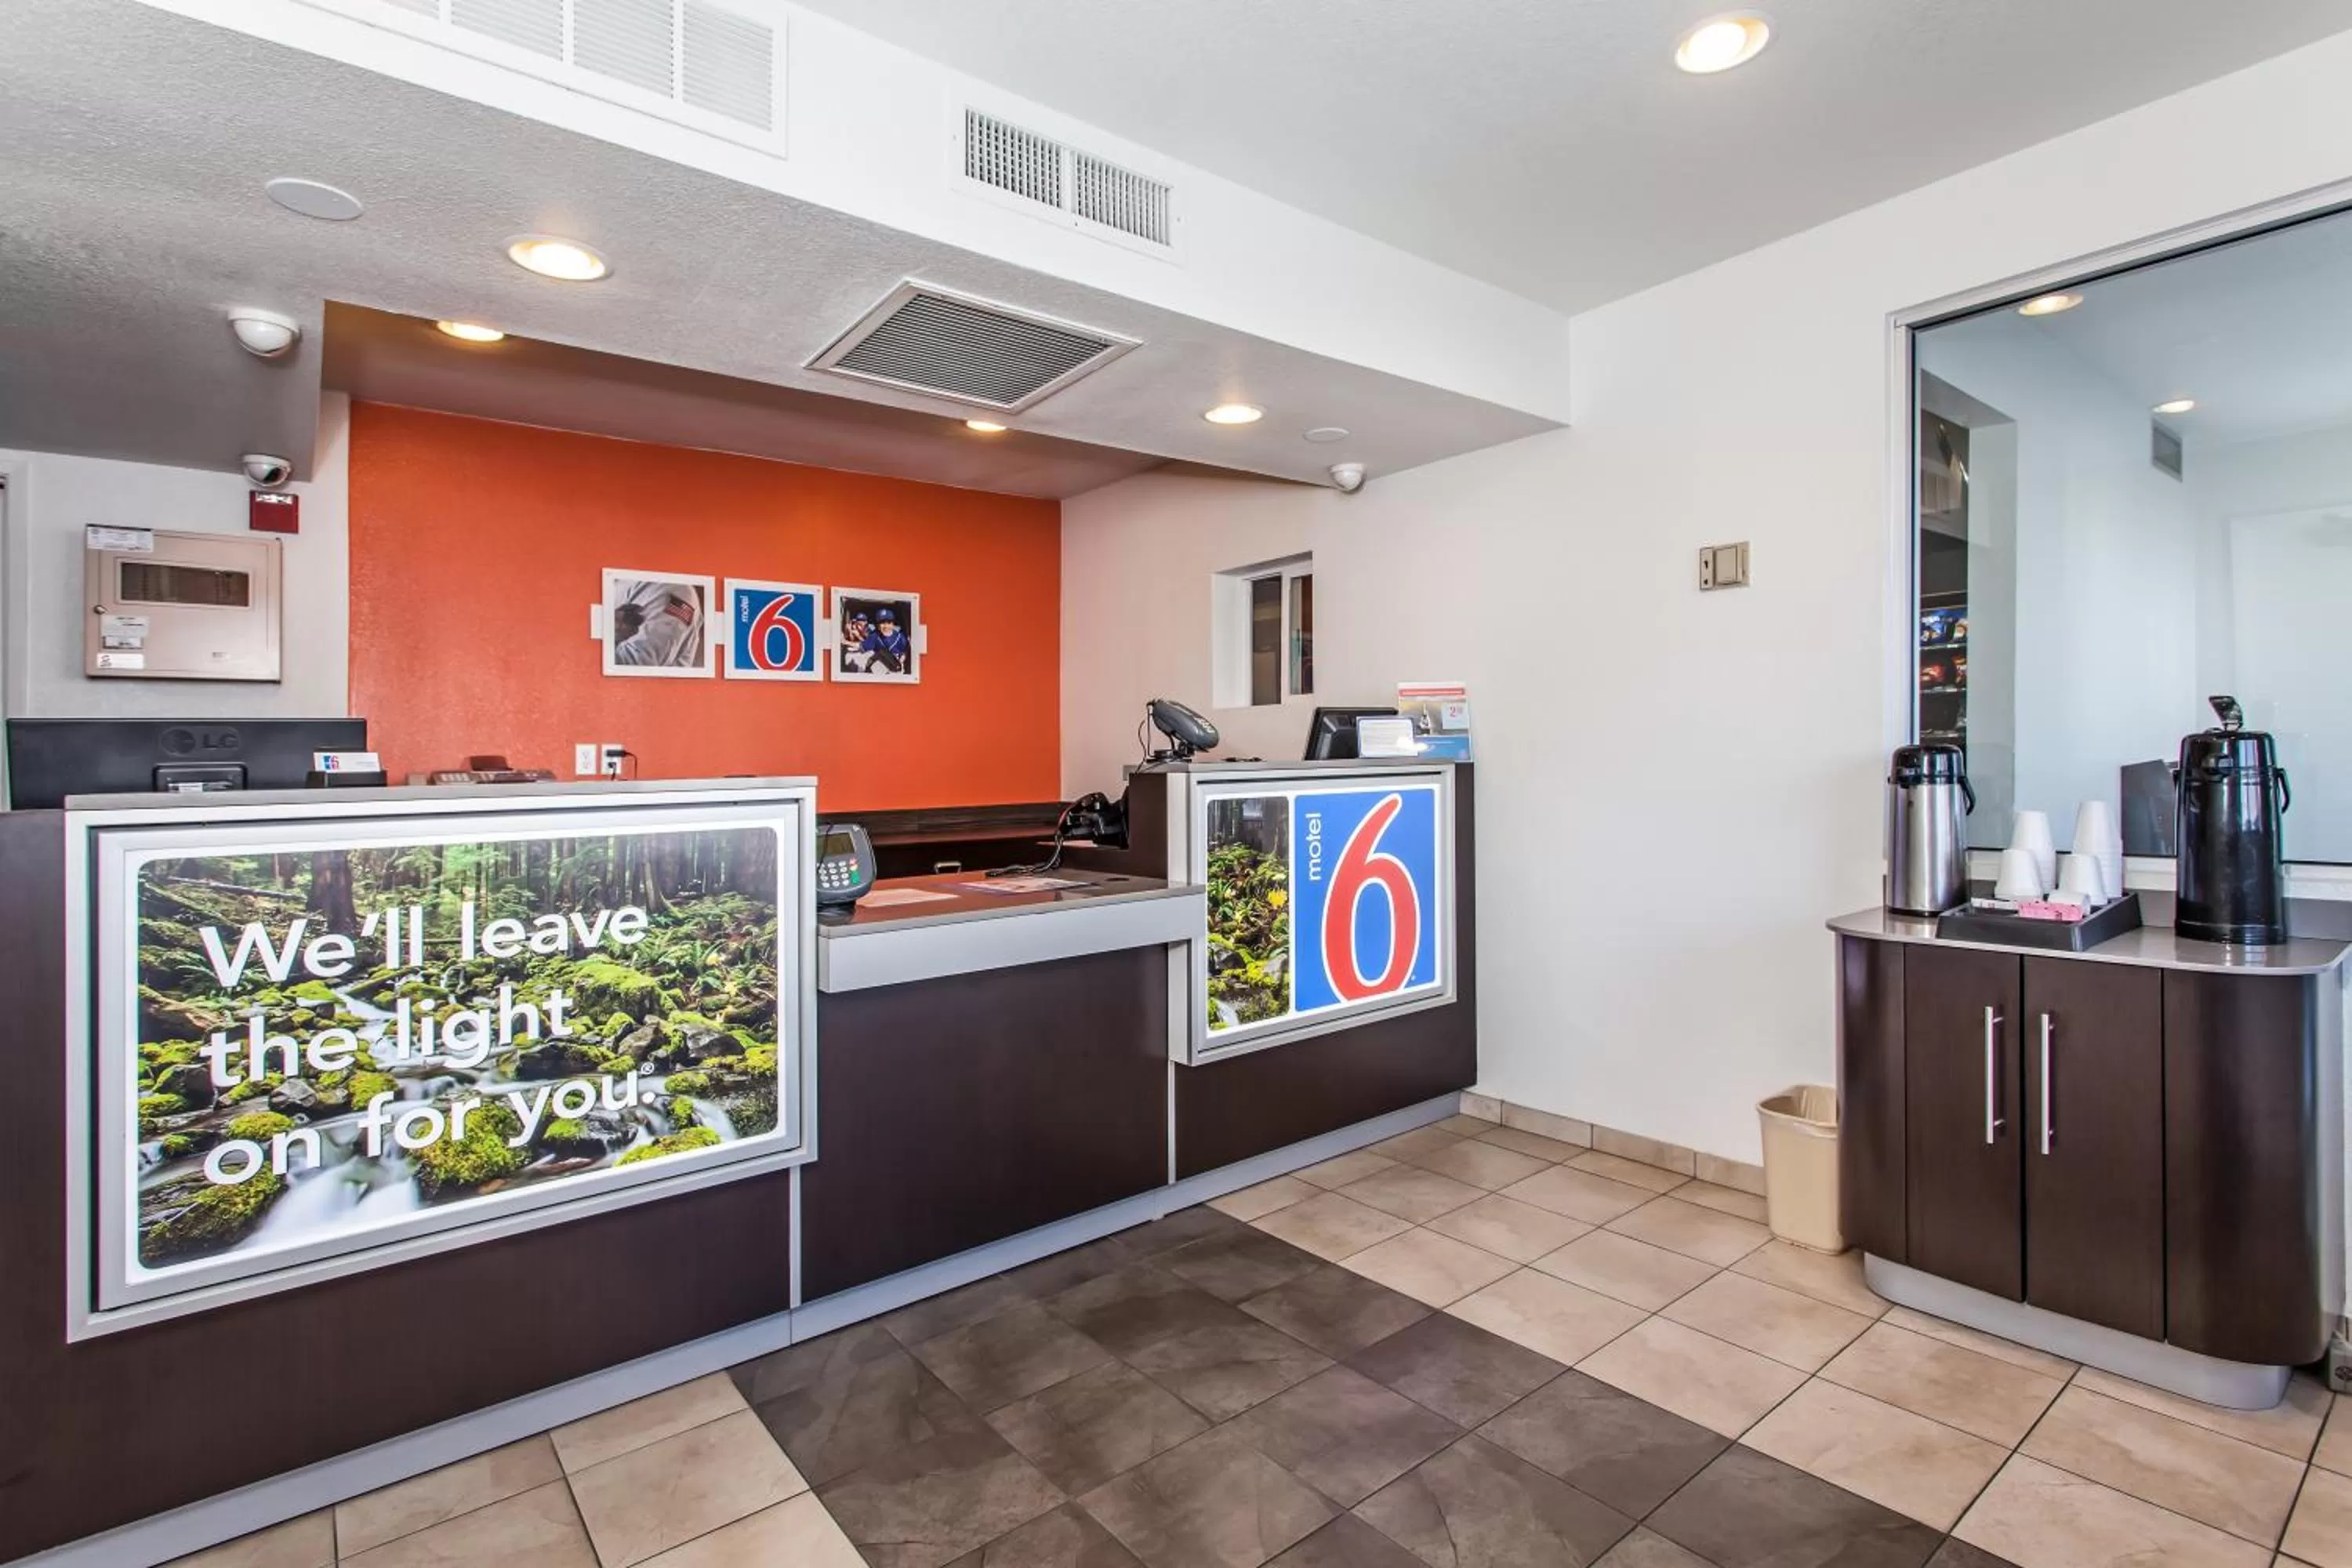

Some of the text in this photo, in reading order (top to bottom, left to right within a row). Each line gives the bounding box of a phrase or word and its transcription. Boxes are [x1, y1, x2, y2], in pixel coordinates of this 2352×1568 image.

[739, 594, 804, 672] motel 6
[201, 733, 238, 749] LG
[1305, 793, 1421, 1004] motel 6
[199, 901, 648, 987] We'll leave
[200, 985, 573, 1088] the light
[204, 1127, 321, 1185] on
[358, 1091, 480, 1158] for
